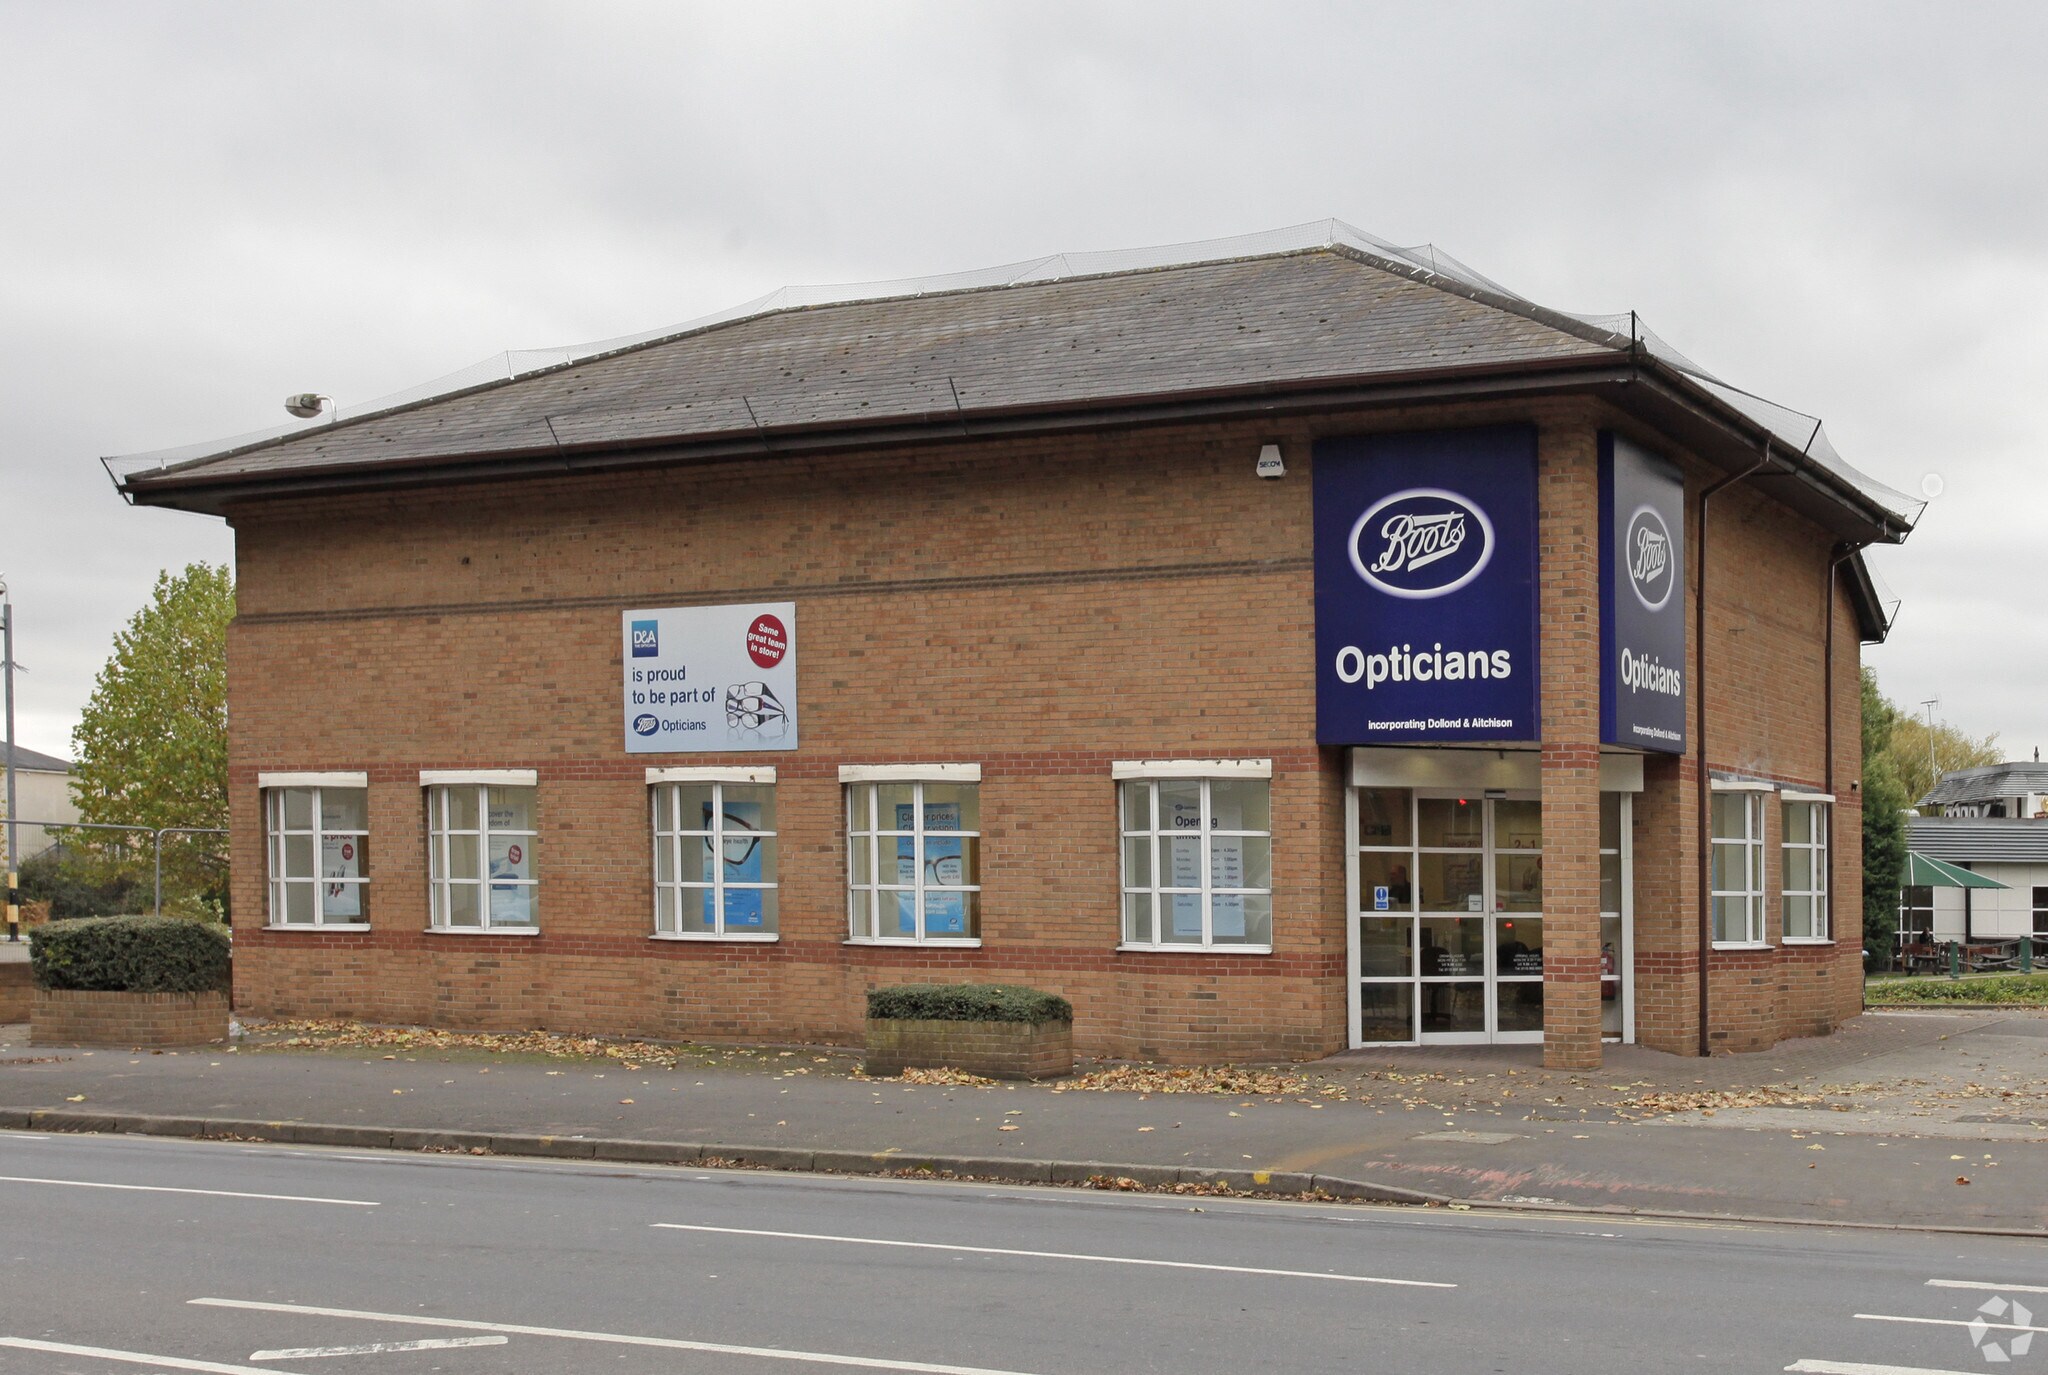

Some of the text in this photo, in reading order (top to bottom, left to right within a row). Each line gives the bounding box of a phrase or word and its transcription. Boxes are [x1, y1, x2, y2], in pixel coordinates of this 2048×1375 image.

[1370, 510, 1466, 573] Boots
[1633, 526, 1666, 584] Boots
[633, 630, 657, 644] D&A
[758, 622, 779, 637] Same
[747, 632, 786, 650] great team
[750, 642, 780, 659] in store!
[632, 665, 686, 685] is proud
[1335, 642, 1512, 690] Opticians
[1621, 647, 1681, 697] Opticians
[632, 686, 716, 706] to be part of
[661, 719, 706, 733] Opticians
[1368, 717, 1513, 731] incorporating Dollond & Aitchison
